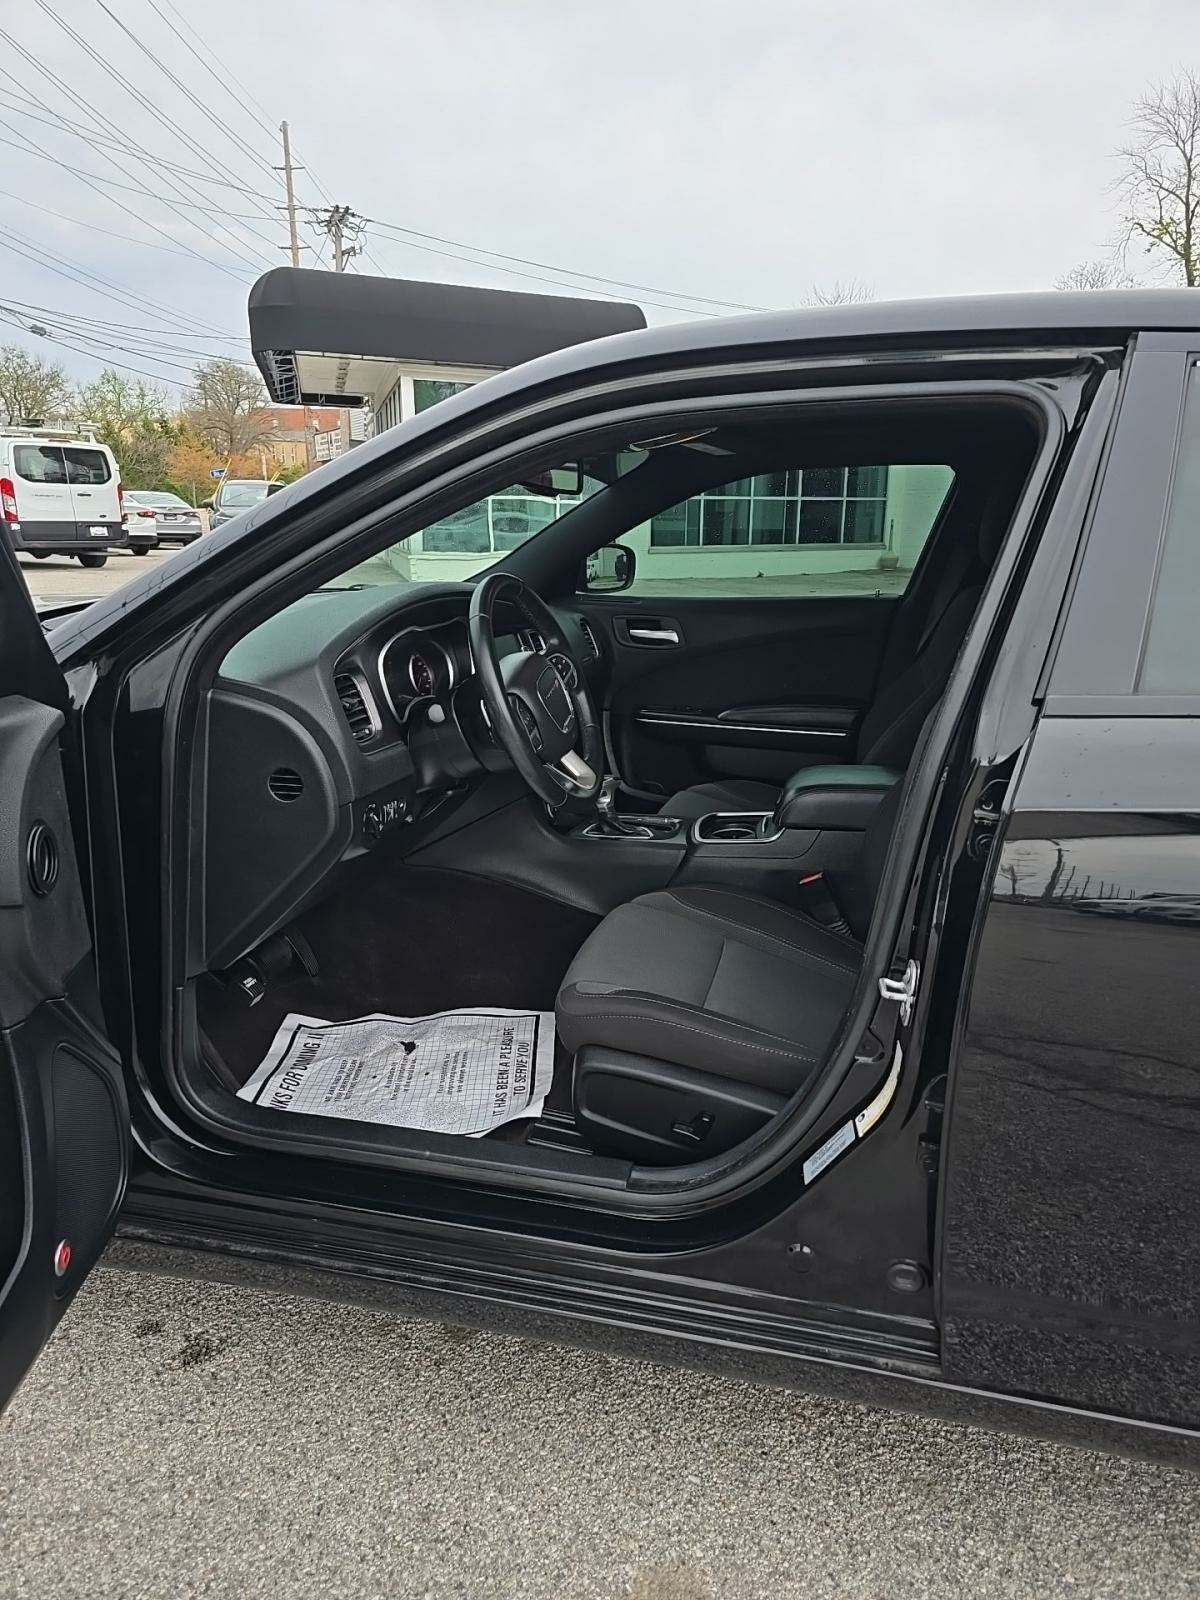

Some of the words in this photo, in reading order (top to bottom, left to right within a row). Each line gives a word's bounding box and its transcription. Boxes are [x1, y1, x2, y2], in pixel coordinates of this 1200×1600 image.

[500, 1027, 514, 1060] PLEASURE
[517, 1042, 530, 1058] YOU
[279, 1071, 304, 1092] FOR
[496, 1069, 510, 1091] BEEN
[515, 1059, 528, 1083] SERVE
[494, 1092, 507, 1108] HAS
[513, 1085, 526, 1096] TO
